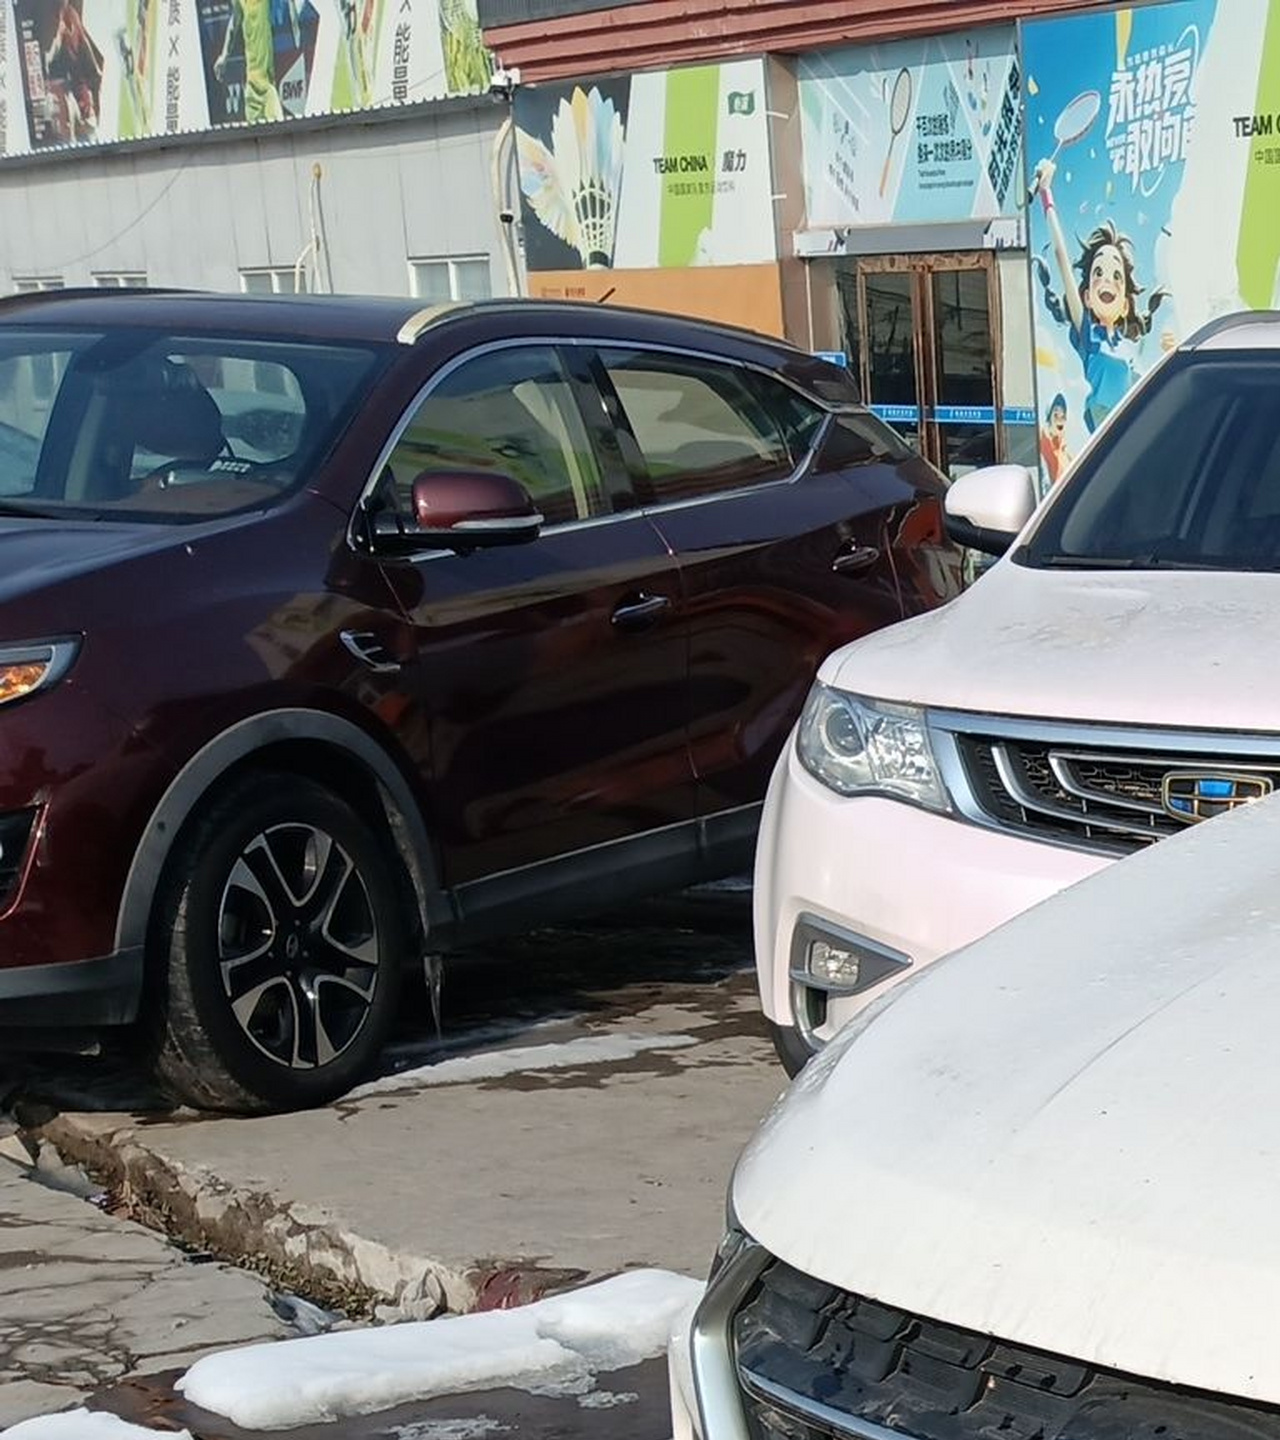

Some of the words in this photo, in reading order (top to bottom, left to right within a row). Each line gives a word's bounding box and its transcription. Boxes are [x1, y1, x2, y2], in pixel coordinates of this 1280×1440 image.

[1233, 114, 1273, 138] TEAM
[653, 156, 679, 174] TEAM
[679, 154, 708, 173] CHINA
[721, 149, 748, 172] 魔力
